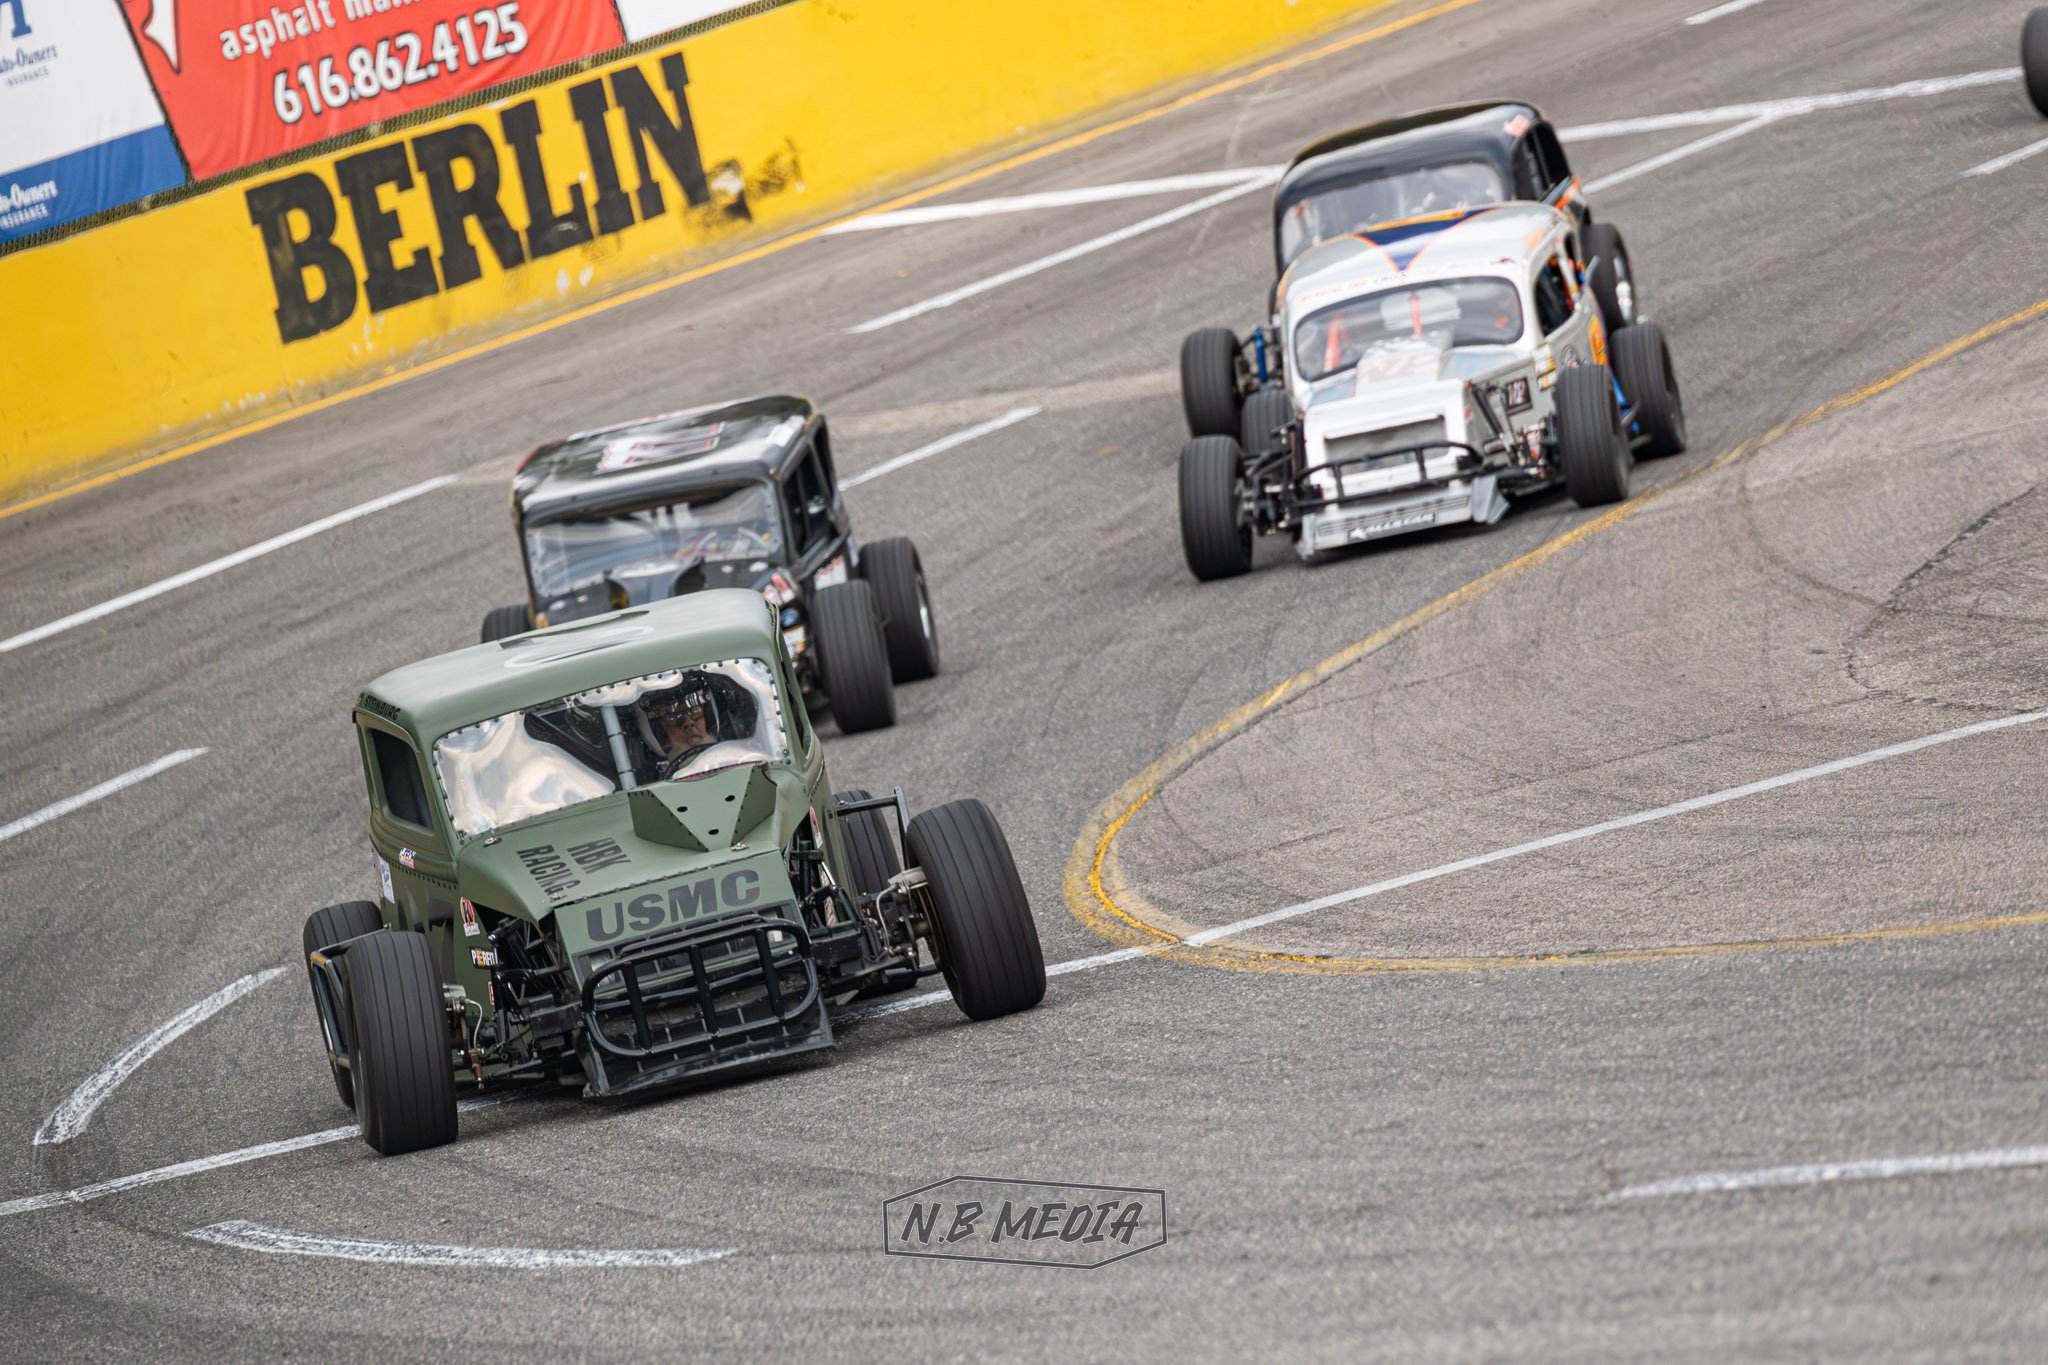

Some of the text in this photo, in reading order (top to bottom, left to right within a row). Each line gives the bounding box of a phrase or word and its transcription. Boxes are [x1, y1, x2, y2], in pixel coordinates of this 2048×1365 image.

[219, 0, 335, 60] asphalt
[273, 1, 529, 124] 616.862.4125
[245, 52, 710, 344] BERLIN
[567, 837, 631, 875] HBK
[585, 869, 761, 942] USMC
